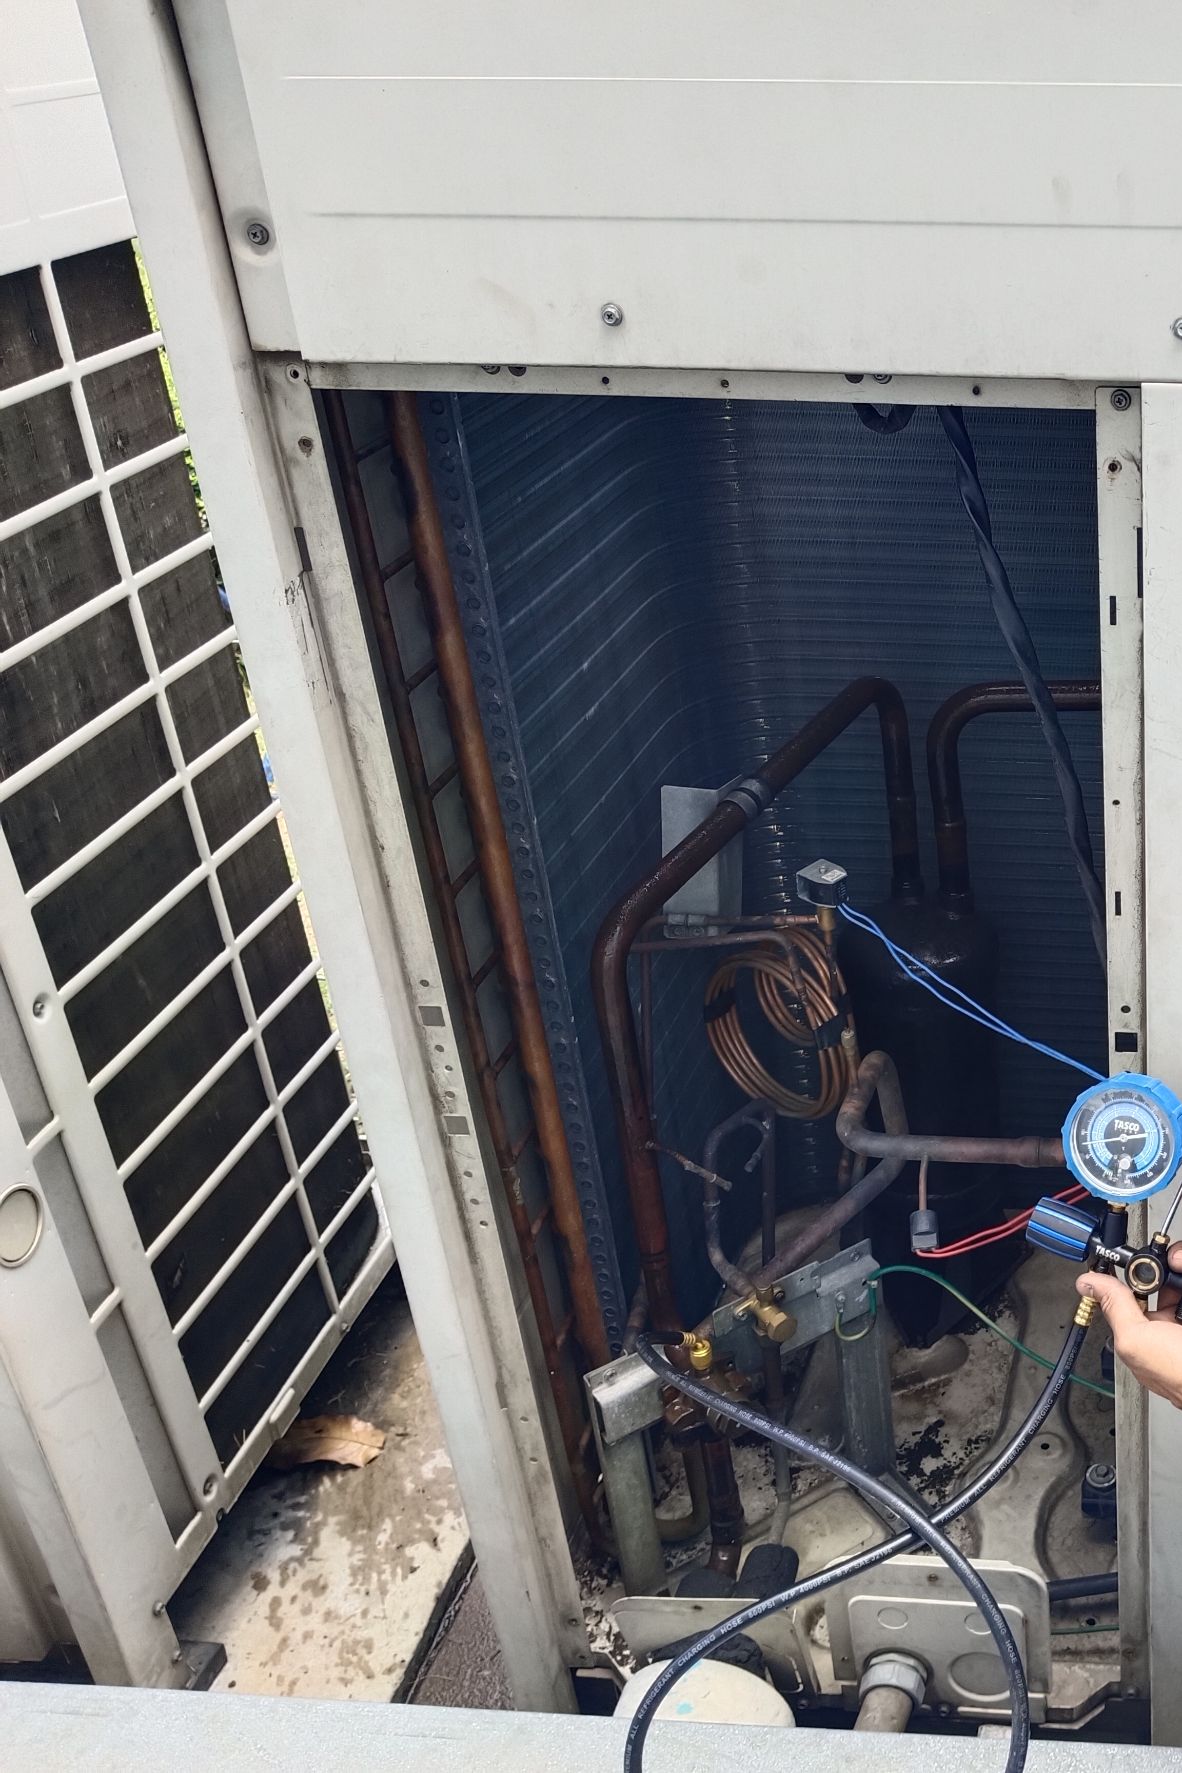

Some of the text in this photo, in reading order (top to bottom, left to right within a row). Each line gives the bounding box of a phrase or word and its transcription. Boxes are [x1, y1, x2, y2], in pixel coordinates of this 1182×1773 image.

[1114, 1119, 1139, 1132] TASCO
[1095, 1244, 1120, 1262] TASCO
[973, 1482, 987, 1498] ALL
[1028, 1398, 1054, 1435] CHARGING
[1053, 1373, 1066, 1395] HOSE
[981, 1592, 1007, 1635] CHARGING
[1005, 1639, 1018, 1664] HOSE
[630, 1724, 640, 1741] ALL
[637, 1667, 677, 1720] REFRIGERANT
[677, 1634, 716, 1667] CHARGING
[720, 1616, 744, 1635] HOSE
